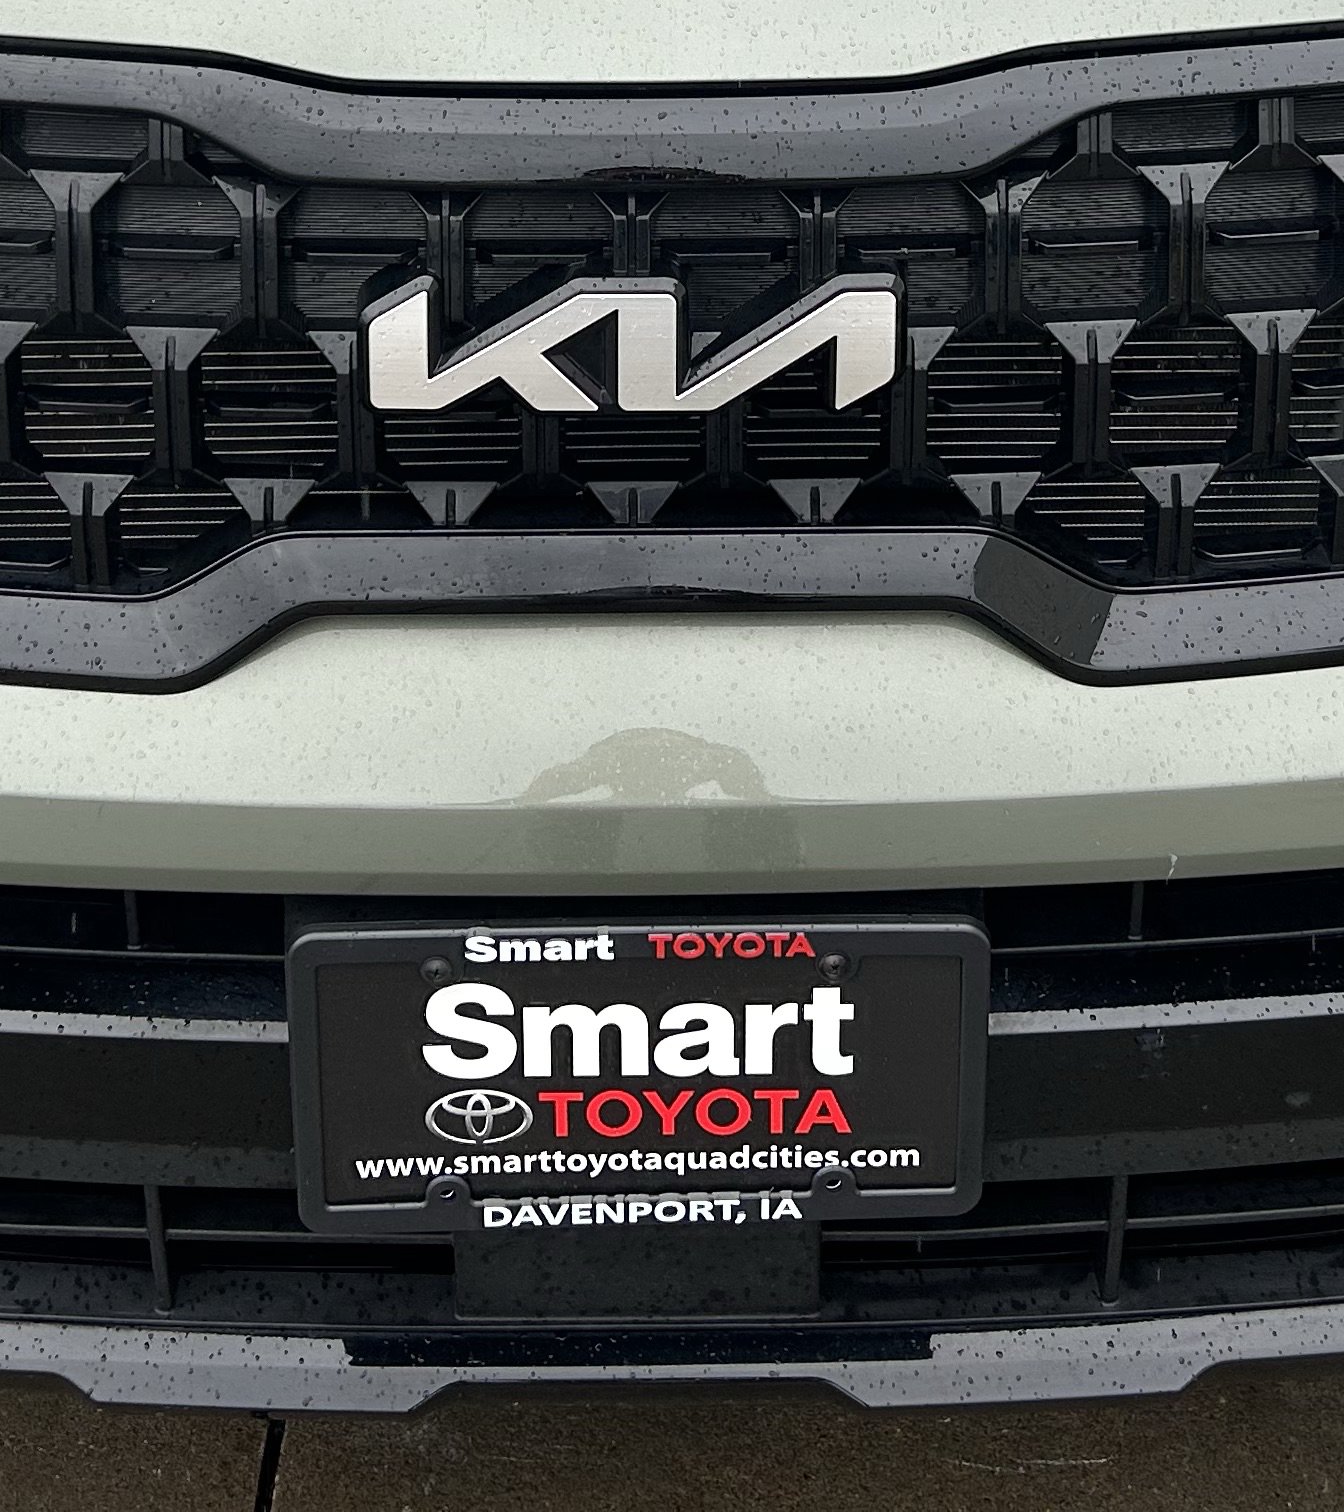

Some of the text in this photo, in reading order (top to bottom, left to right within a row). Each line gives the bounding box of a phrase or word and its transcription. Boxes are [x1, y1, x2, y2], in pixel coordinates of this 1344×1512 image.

[368, 290, 897, 412] KIA
[464, 932, 817, 963] Smart TOYOTA
[422, 982, 855, 1080] Smart
[539, 1089, 852, 1138] TOYOTA
[355, 1144, 921, 1179] www.smarttoyotaquadcities.com
[483, 1198, 804, 1228] DAVENPORT, IA
